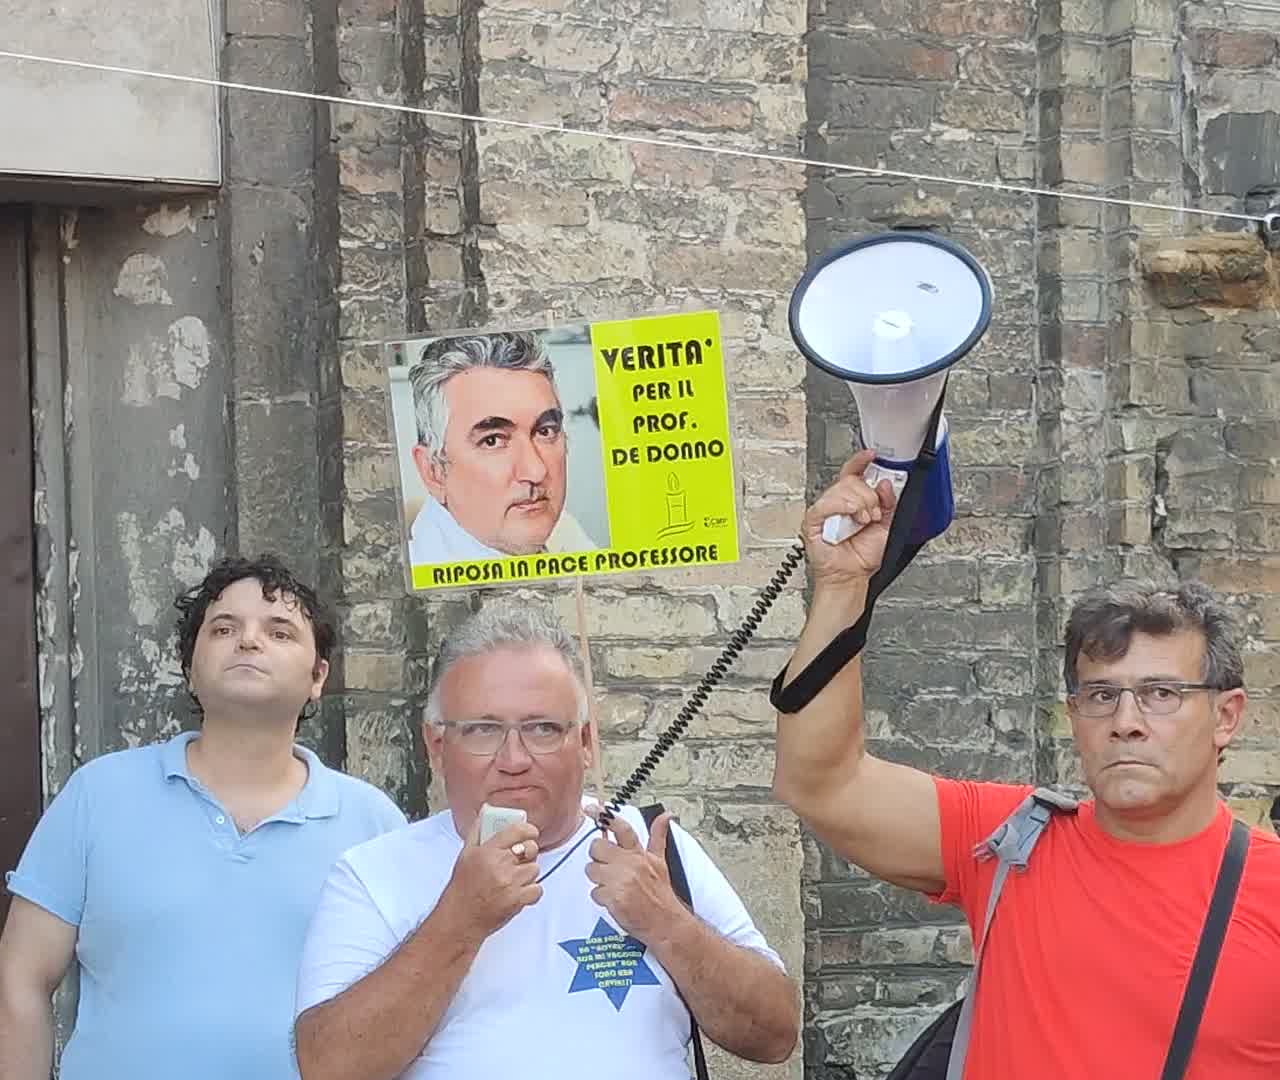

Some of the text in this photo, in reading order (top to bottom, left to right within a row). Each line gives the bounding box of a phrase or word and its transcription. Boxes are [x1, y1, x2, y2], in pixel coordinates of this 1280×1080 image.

[632, 380, 694, 402] PER IL
[633, 411, 697, 434] PROF.
[612, 439, 724, 466] DE DONNO
[433, 544, 718, 584] RIPOSA IN PACE PROFESSORE
